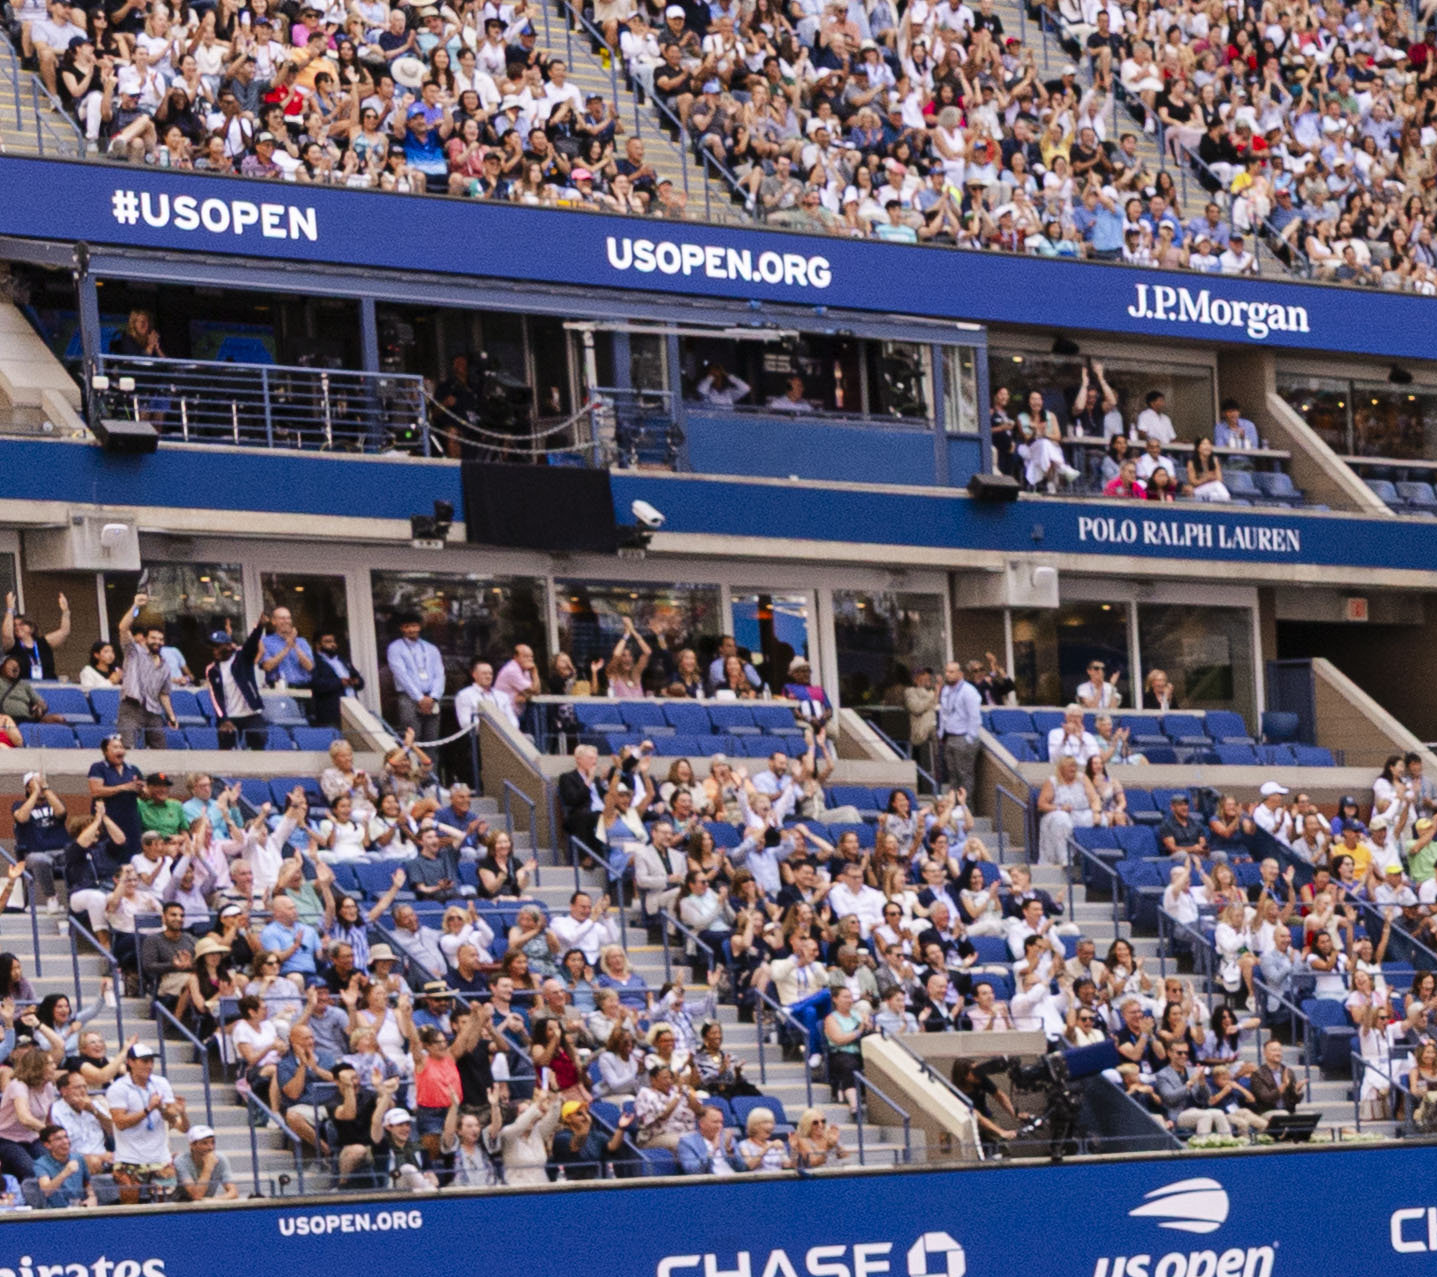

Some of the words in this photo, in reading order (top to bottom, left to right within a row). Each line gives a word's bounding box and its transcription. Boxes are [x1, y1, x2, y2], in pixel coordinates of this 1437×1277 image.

[111, 189, 318, 241] #USOPEN
[606, 236, 832, 289] USOPEN.ORG
[1127, 283, 1310, 339] J.P.Morgan
[1078, 516, 1138, 543] POLO
[1142, 520, 1213, 548] RALPH
[1218, 524, 1300, 552] LAUREN
[278, 1210, 423, 1237] USOPEN.ORG
